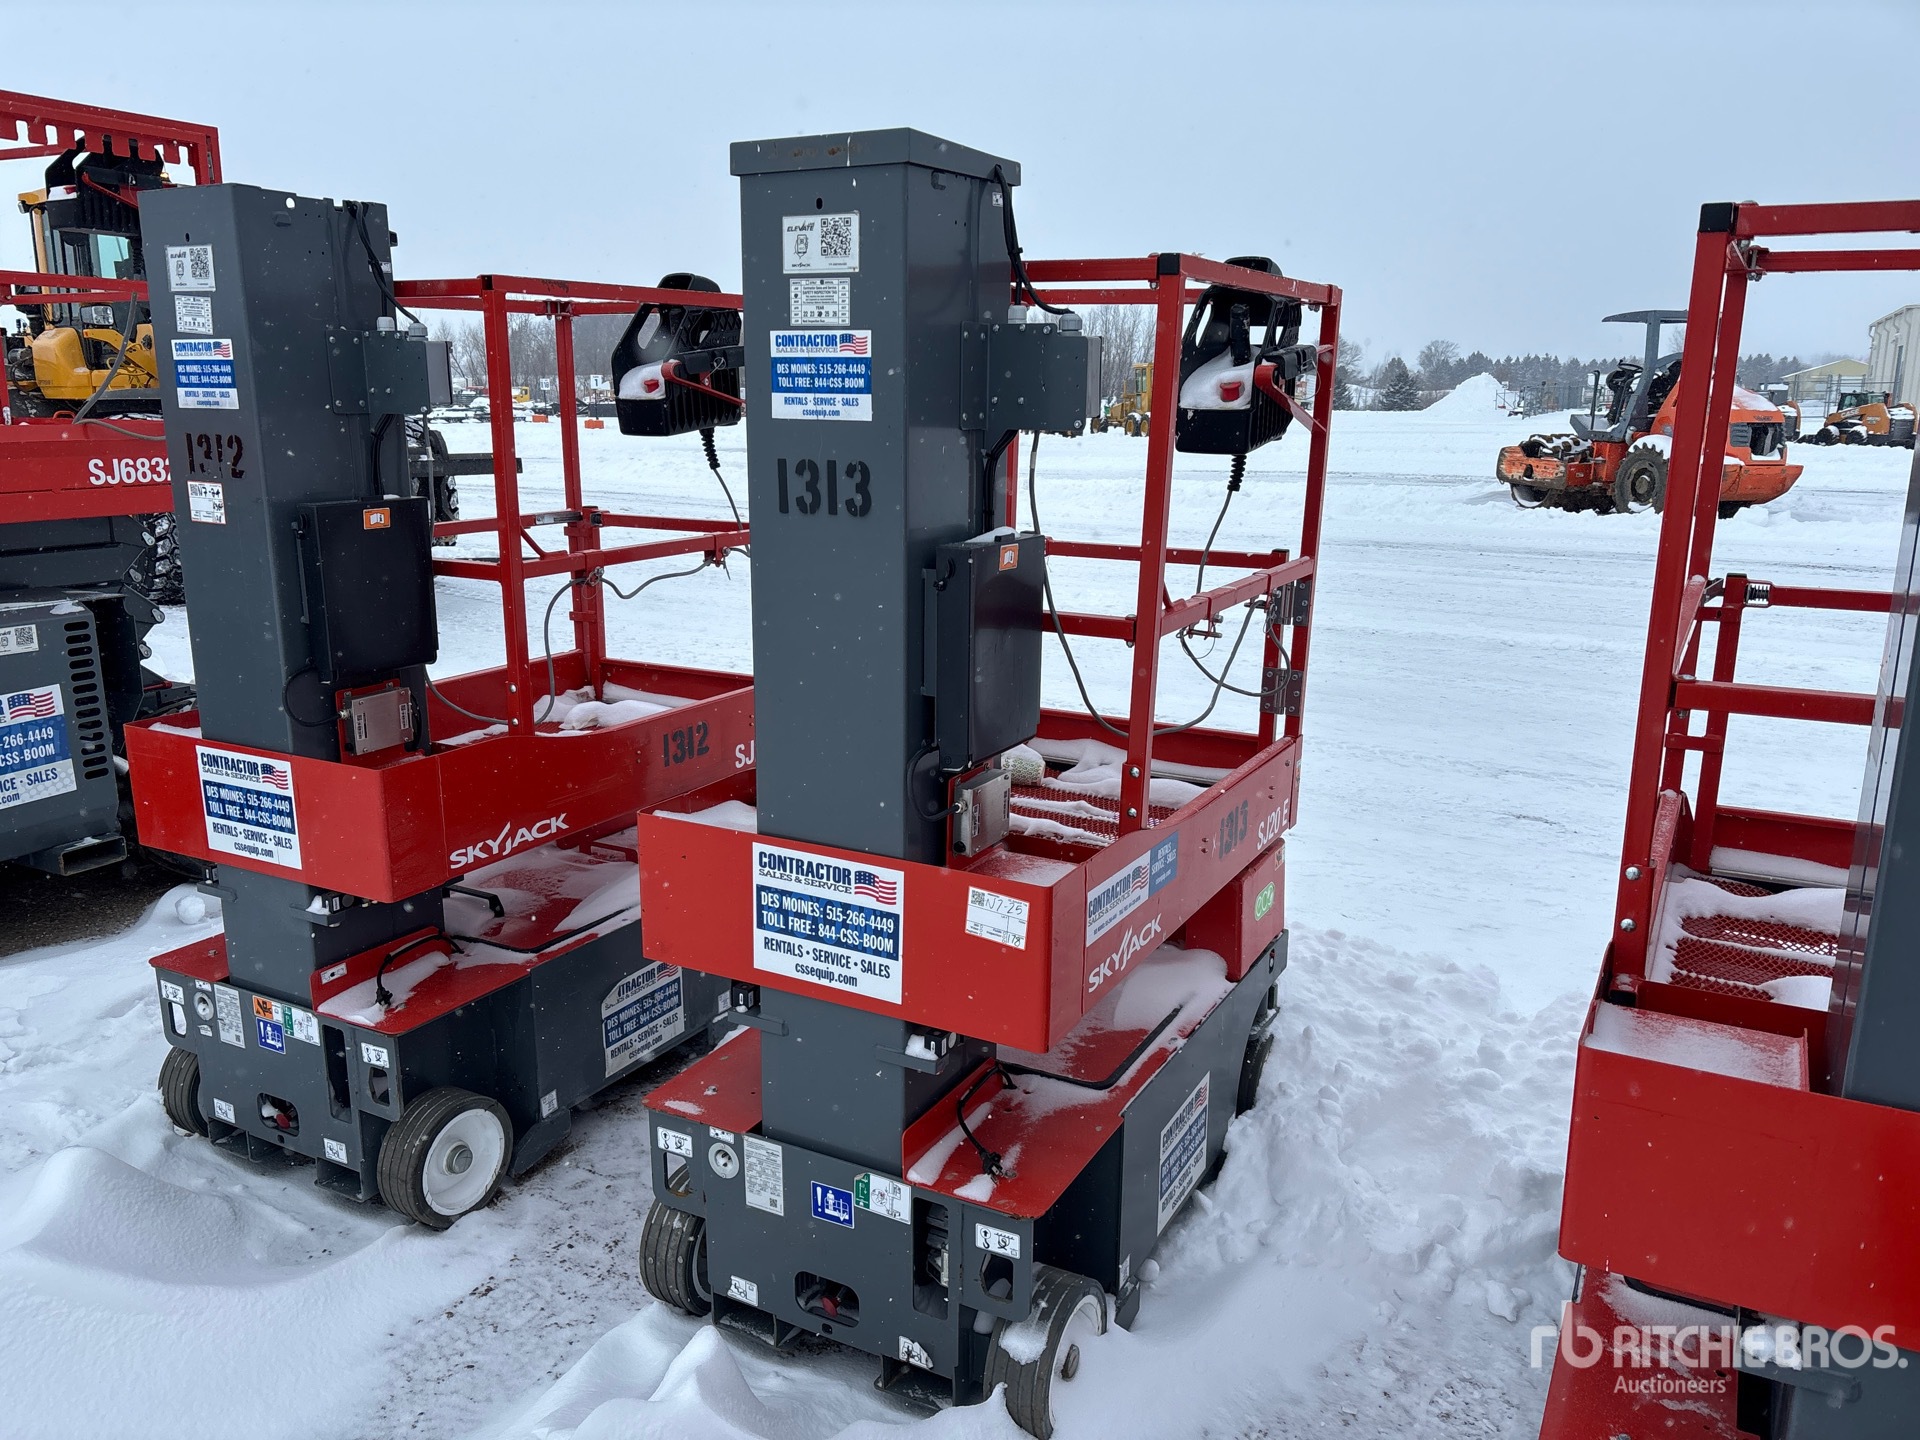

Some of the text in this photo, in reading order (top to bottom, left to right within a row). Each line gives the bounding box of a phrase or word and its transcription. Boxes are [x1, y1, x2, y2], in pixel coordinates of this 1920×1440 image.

[776, 334, 837, 347] CONTRACTOR
[777, 364, 865, 374] DES MOINES: 515-266-4449
[778, 377, 864, 388] TOLL FREE: 844-CSS-BOOM
[784, 397, 859, 406] RENTALS SERVICE SALES
[803, 408, 840, 418] cssequip.com
[1841, 408, 1860, 418] CASE
[778, 458, 871, 517] 1313
[664, 721, 710, 767] 1312
[26, 767, 58, 786] SALES
[201, 752, 260, 776] CONTRACTOR
[202, 767, 224, 776] SALES
[231, 772, 261, 783] SERVICE
[206, 785, 290, 812] DES MOINES: 515-266-4449
[208, 801, 291, 828] TOLL FREE: 844-CSS-BOOM
[1257, 806, 1280, 850] SJ20
[1282, 799, 1288, 826] E
[213, 822, 292, 849] RENTALS SERVICE SALES
[450, 813, 569, 869] SKYJACK
[234, 842, 274, 858] cssequip.com
[759, 851, 852, 885] CONTRACTOR
[759, 869, 852, 894] SALES & SERVICE
[1089, 873, 1131, 918] CONTRACTOR
[761, 891, 894, 933] DES MOINES: 515-266-4449
[1088, 910, 1104, 927] SALES
[762, 911, 893, 953] TOLL FREE: 844-CSS-BOOM
[764, 937, 890, 978] RENTALS SERVICE SALES
[1088, 913, 1162, 993] SKYJACK
[795, 963, 857, 987] cssequip.com
[607, 1016, 618, 1029] DES
[619, 1004, 641, 1022] MOINES:
[608, 1029, 622, 1042] TOLL
[624, 1020, 639, 1034] FREE:
[610, 1013, 678, 1059] RENTALS SERVICE SALES
